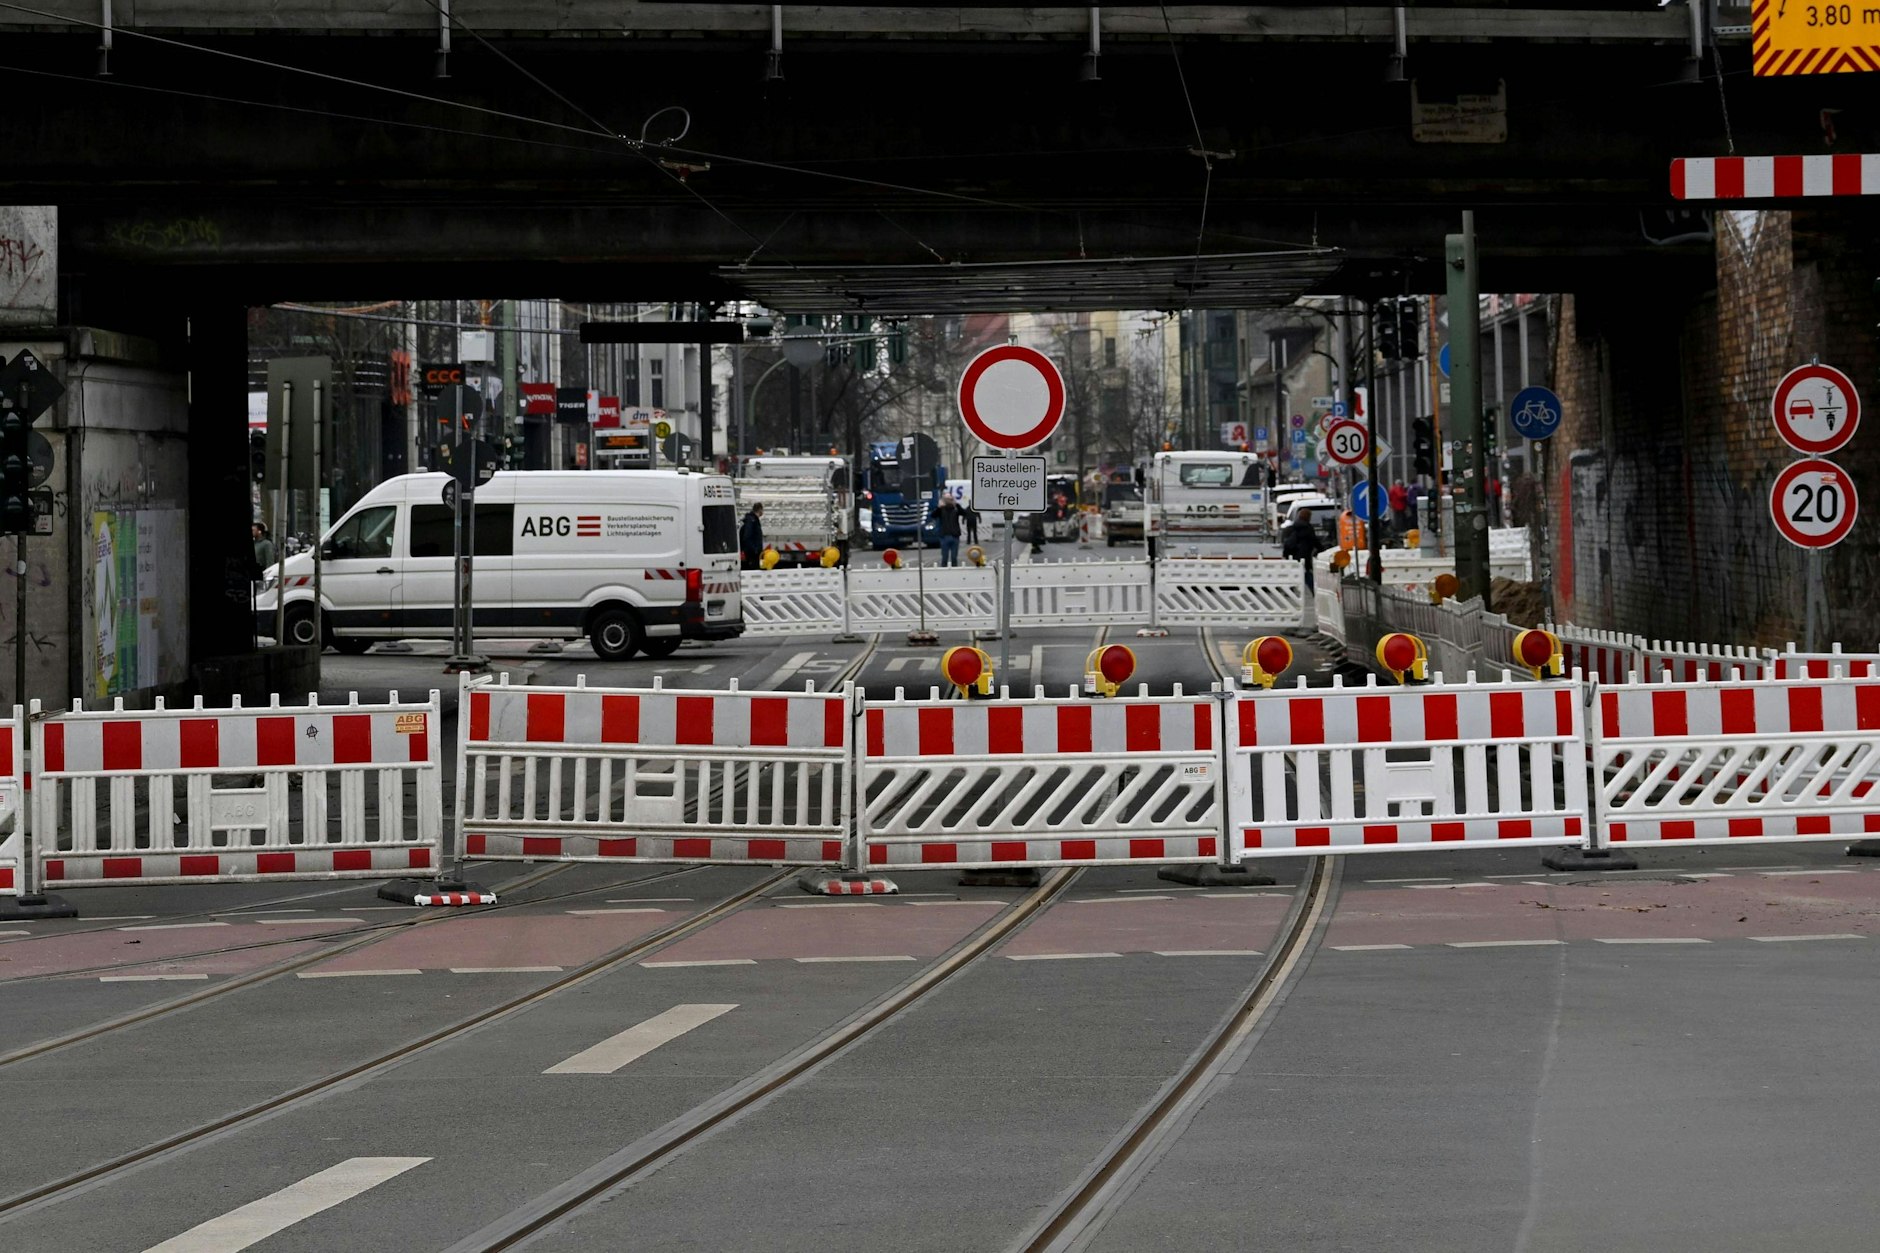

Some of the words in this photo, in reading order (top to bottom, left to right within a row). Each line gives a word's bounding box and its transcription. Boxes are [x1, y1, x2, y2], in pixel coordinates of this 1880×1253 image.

[1806, 4, 1851, 27] 3,80
[1863, 8, 1880, 24] m
[427, 370, 461, 383] CCC
[633, 410, 649, 420] dm
[1336, 433, 1362, 454] 30
[977, 462, 1041, 473] Baustellen-
[980, 477, 1037, 491] fahrzeuge
[998, 493, 1019, 505] frei
[1792, 484, 1838, 523] 20
[607, 515, 674, 523] Baustellenabsicherung
[521, 516, 571, 537] ABG
[607, 530, 662, 538] Lichtsignalanlagen
[396, 715, 423, 723] ABG
